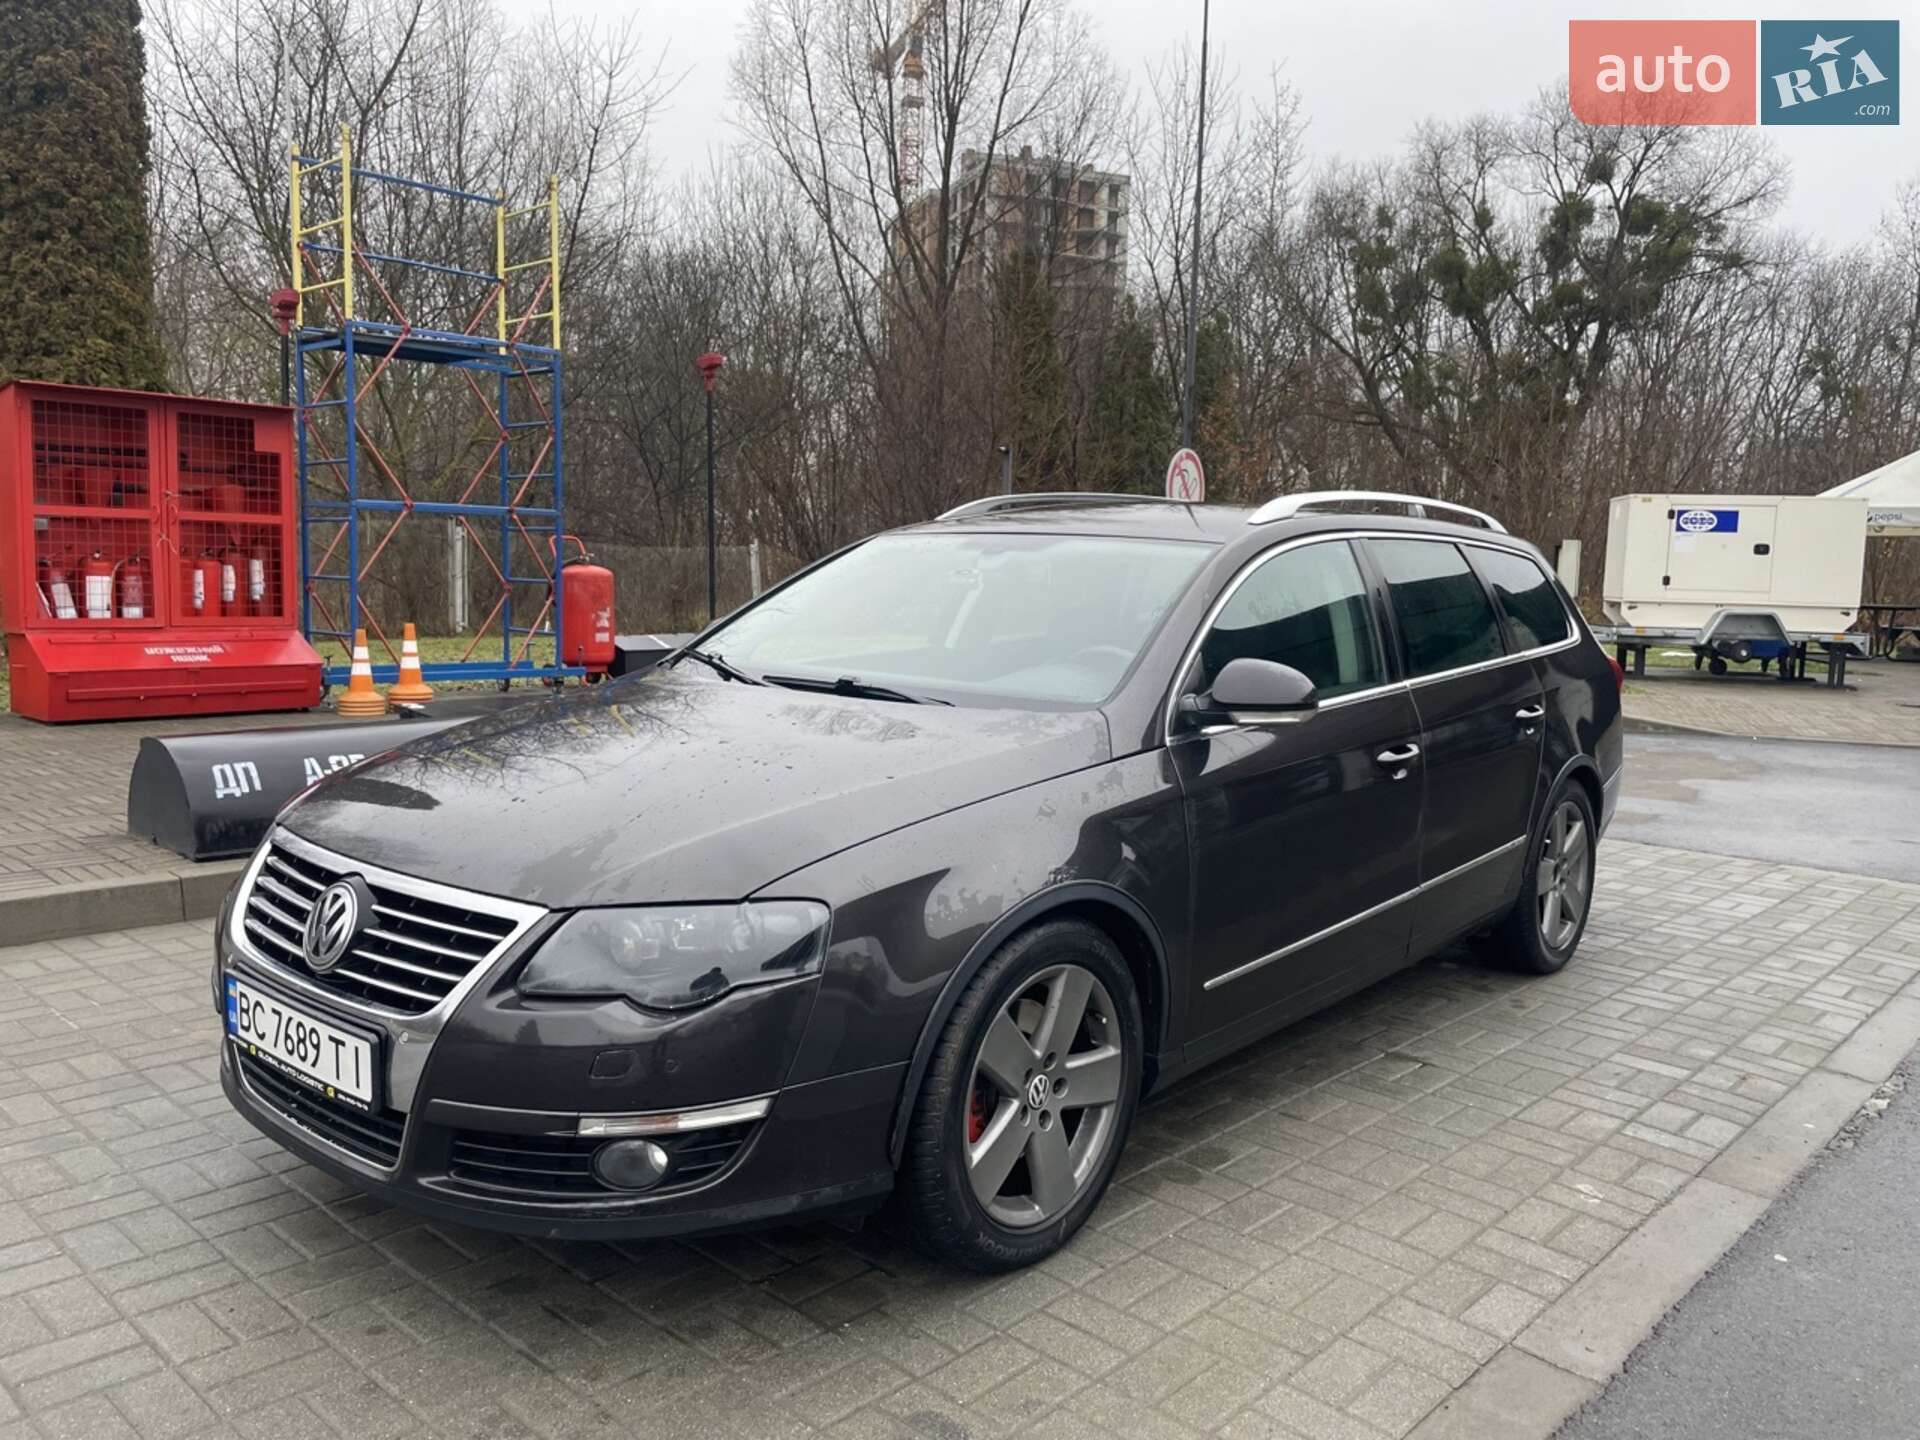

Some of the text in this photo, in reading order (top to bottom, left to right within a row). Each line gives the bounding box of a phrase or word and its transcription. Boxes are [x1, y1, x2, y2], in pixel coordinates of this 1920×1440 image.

[1874, 512, 1903, 522] pepsi
[211, 761, 262, 799] ДП
[239, 991, 361, 1090] BC 7689 TI
